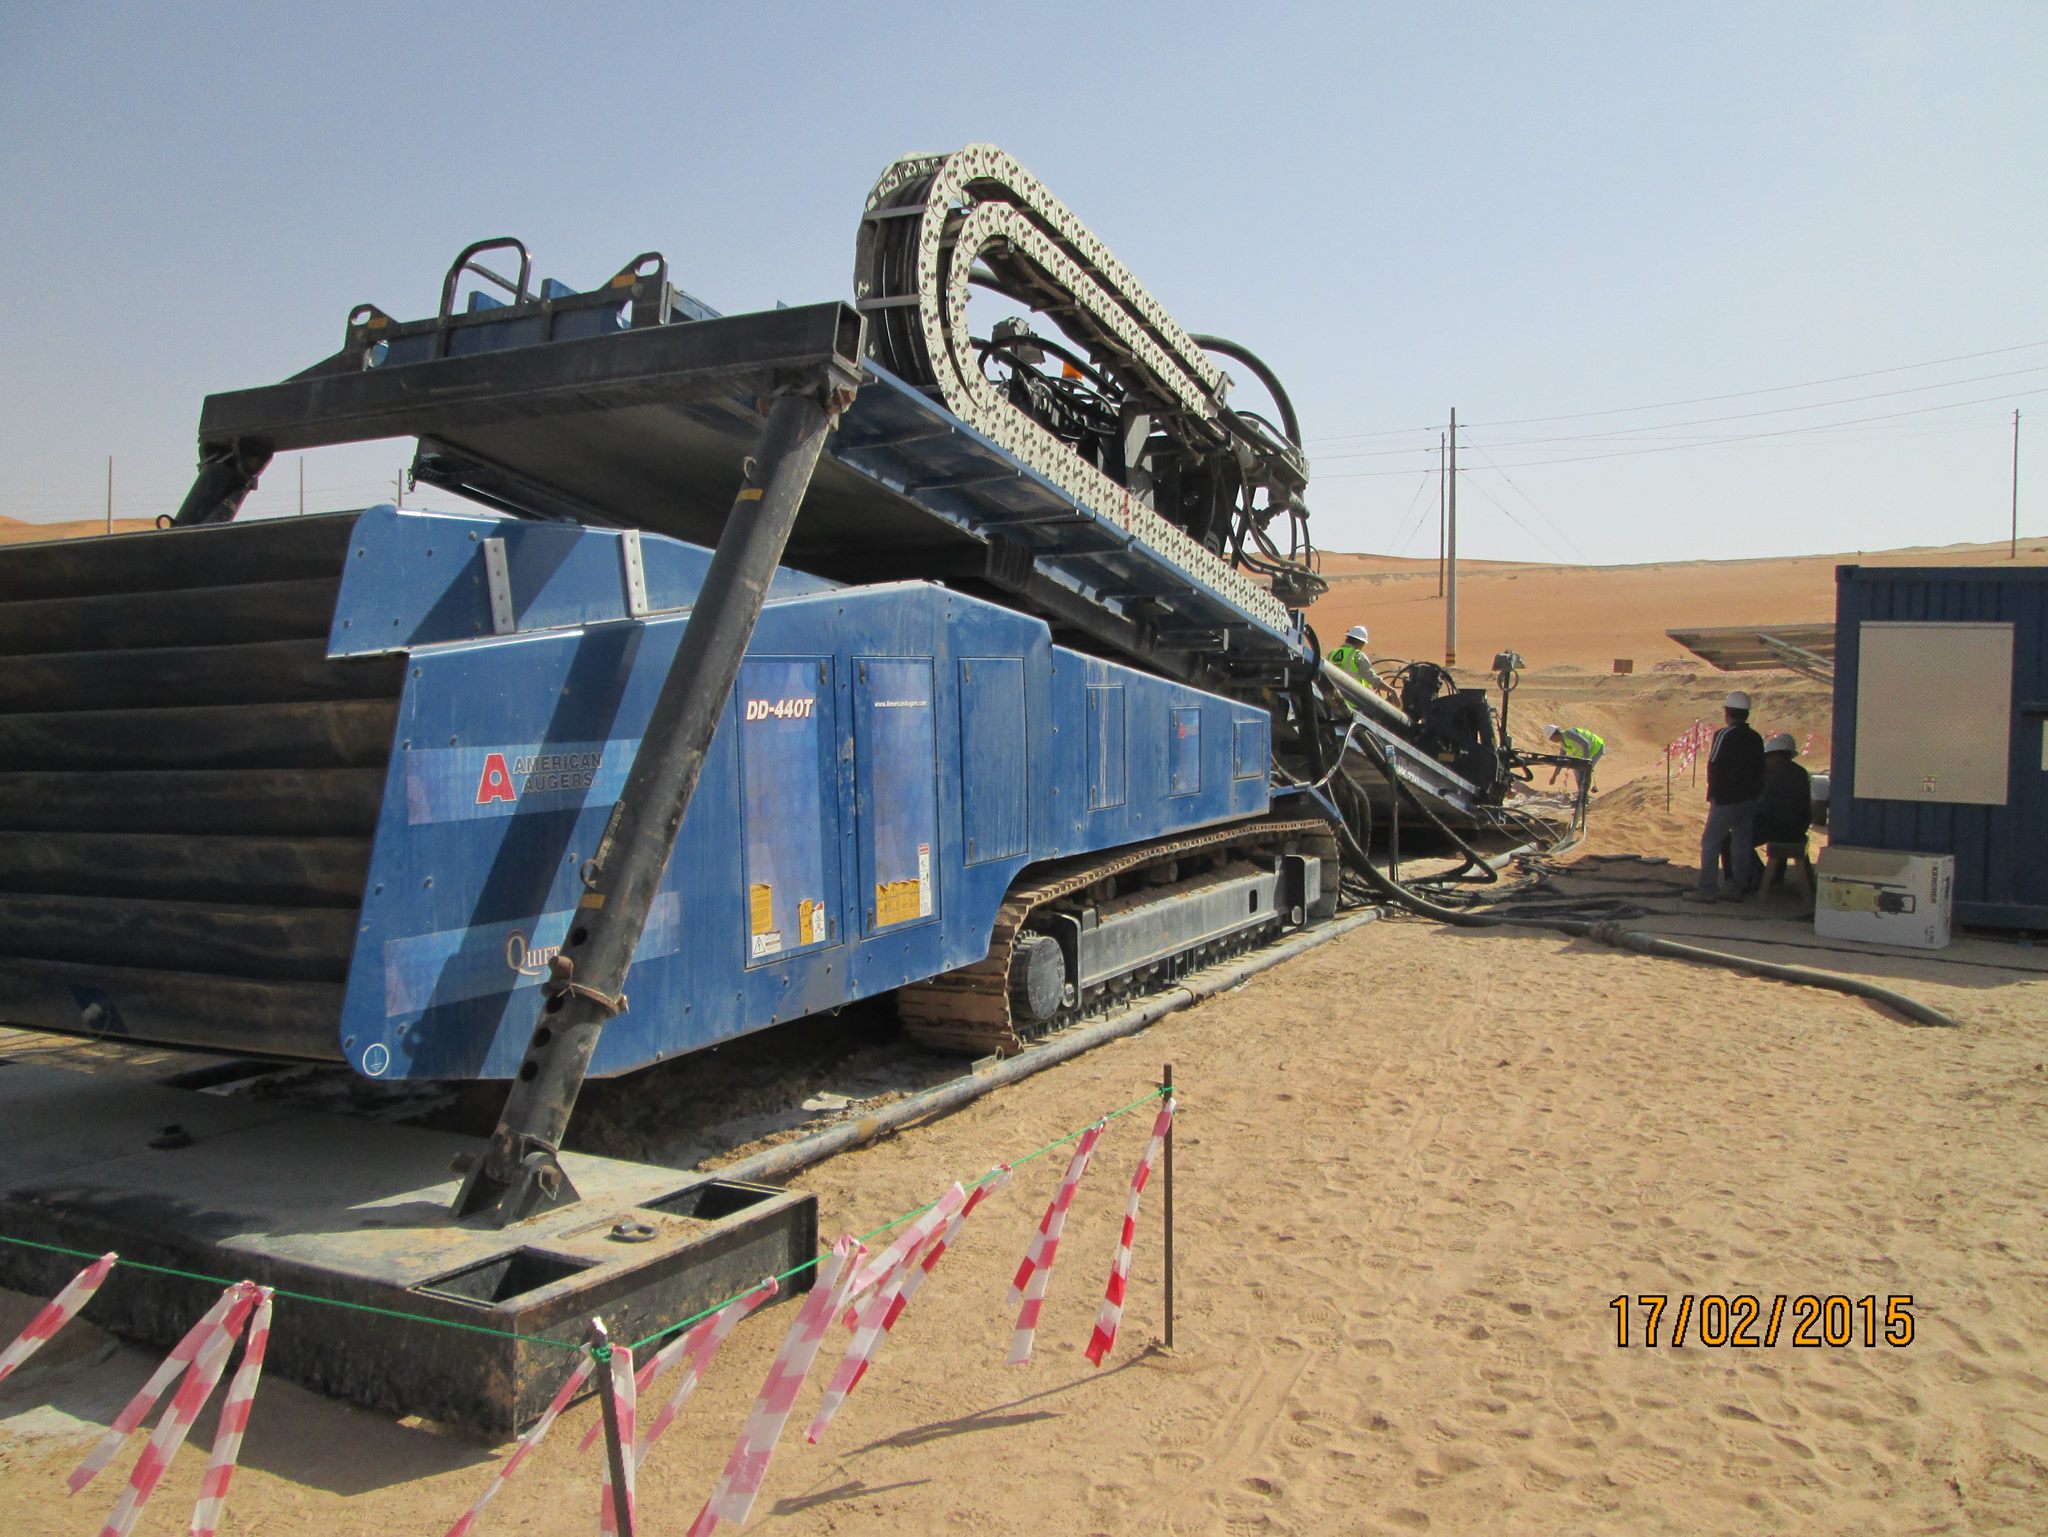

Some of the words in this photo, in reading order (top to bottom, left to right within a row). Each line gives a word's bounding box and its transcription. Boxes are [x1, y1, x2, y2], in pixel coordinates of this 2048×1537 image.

[746, 699, 814, 720] DD-440T
[512, 752, 602, 774] AMERICAN
[522, 772, 593, 793] AUGERS
